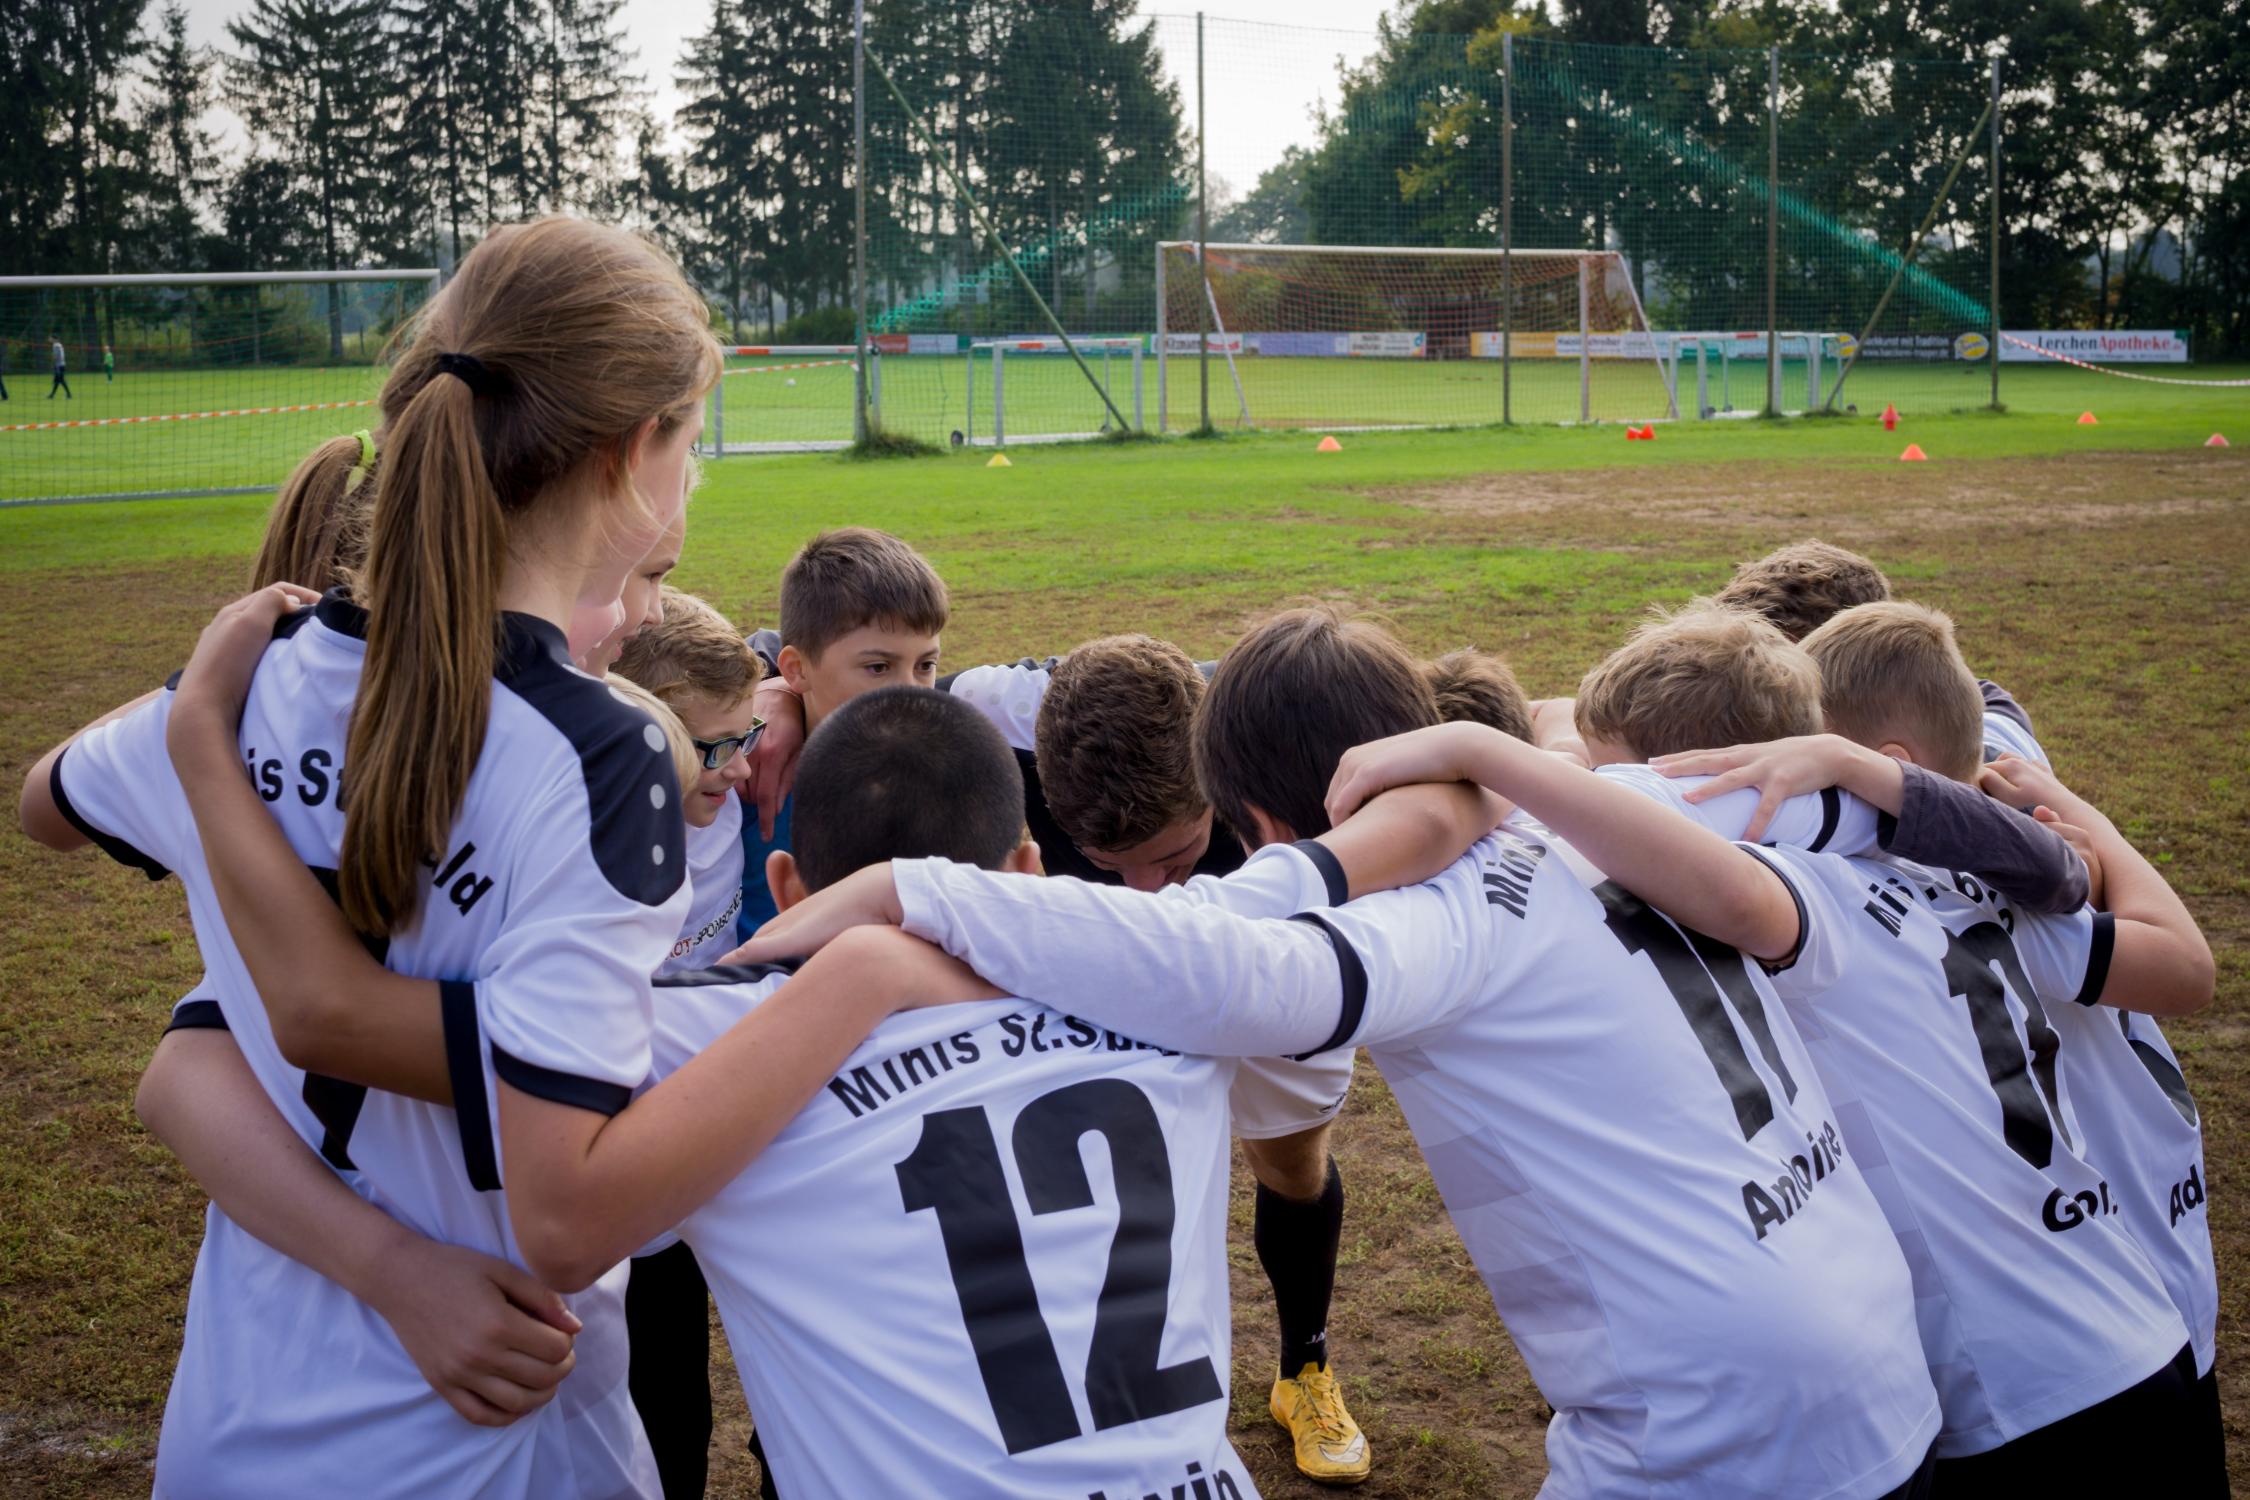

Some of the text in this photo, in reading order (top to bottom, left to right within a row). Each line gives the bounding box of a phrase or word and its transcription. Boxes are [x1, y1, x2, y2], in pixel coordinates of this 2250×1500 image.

[422, 841, 494, 916] ld
[827, 1031, 981, 1118] Minis
[2169, 1163, 2206, 1230] Ad
[894, 1078, 1225, 1455] 12
